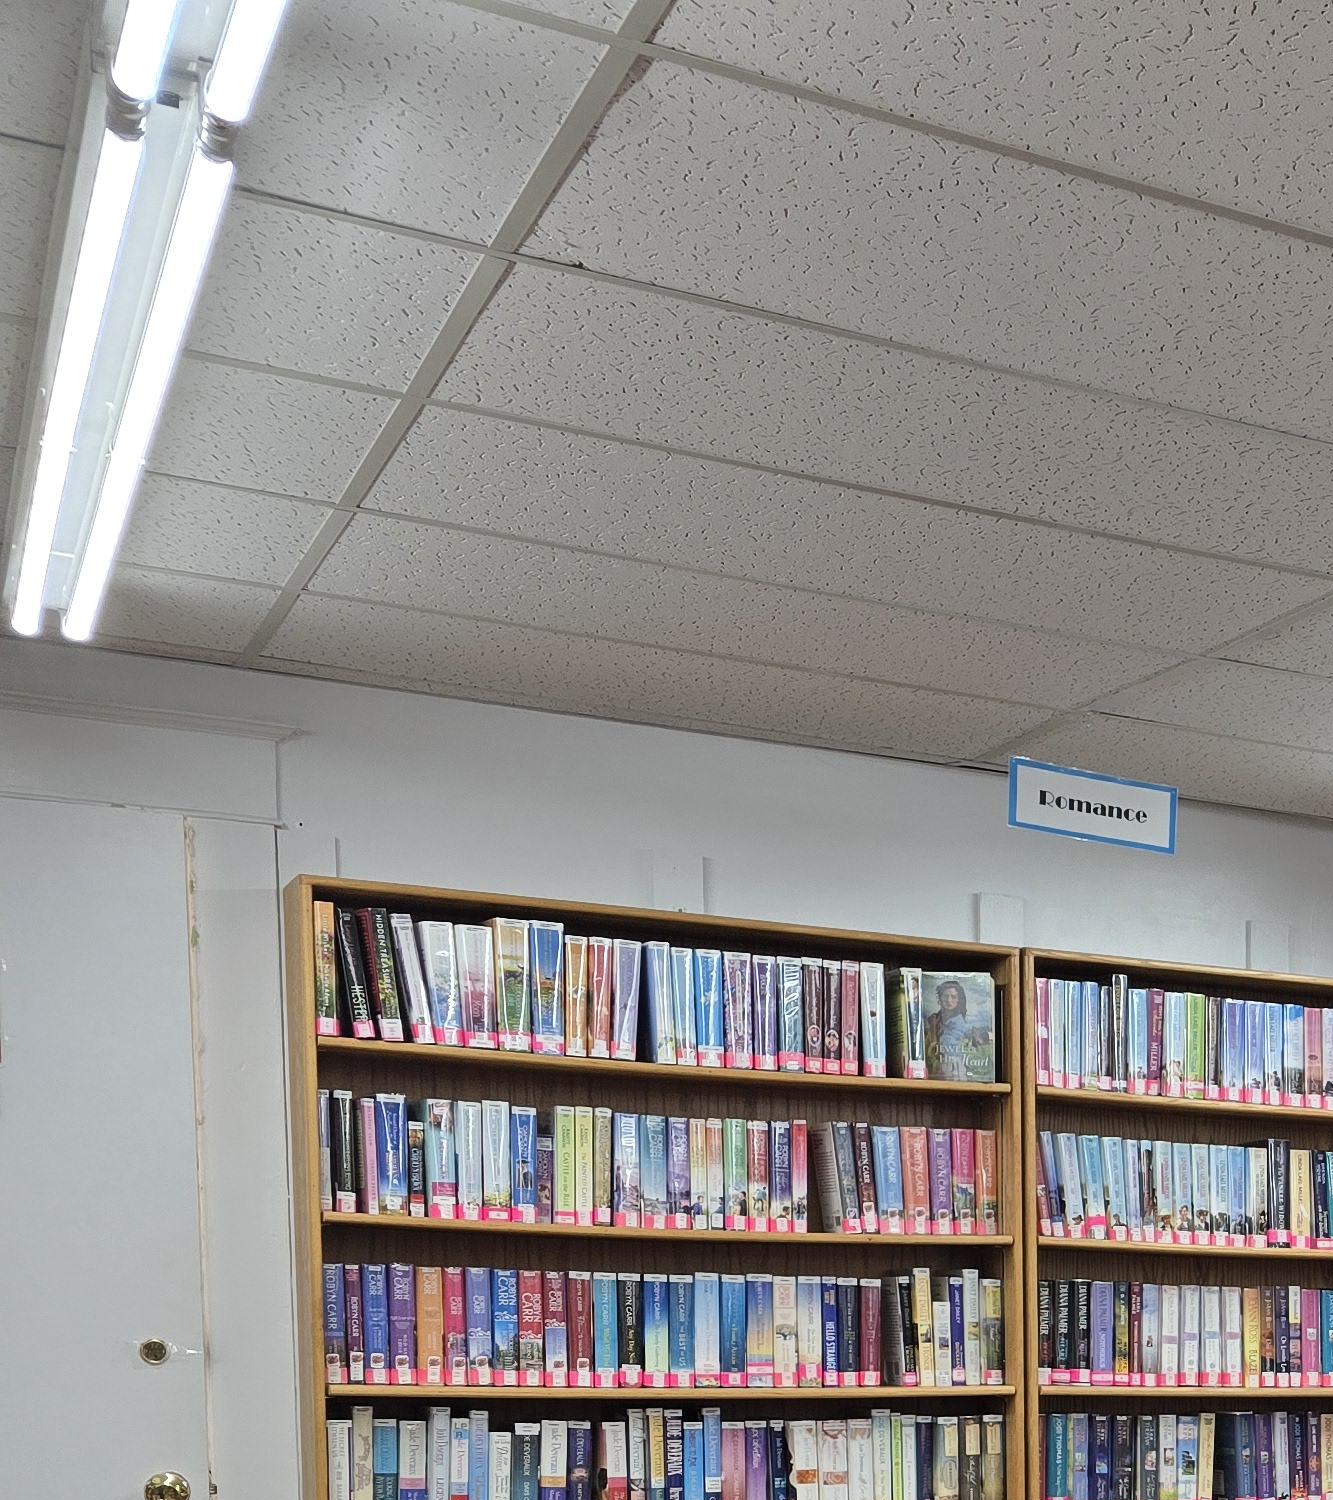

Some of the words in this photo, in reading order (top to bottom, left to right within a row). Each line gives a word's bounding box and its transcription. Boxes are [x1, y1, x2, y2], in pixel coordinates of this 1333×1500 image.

[1039, 789, 1148, 823] Romance
[375, 914, 386, 945] HIDDEN
[379, 946, 392, 994] TREASURES
[1149, 1041, 1158, 1071] MILLER
[910, 1133, 921, 1164] ROBYN
[914, 1166, 924, 1197] CARR
[326, 1269, 336, 1297] ROBYN
[498, 1277, 508, 1305] CARR
[508, 1277, 517, 1306] ROBYN
[327, 1301, 337, 1329] CARR
[522, 1292, 532, 1322] CARR
[532, 1293, 541, 1324] ROBYN
[1247, 1324, 1257, 1345] ROSS
[1248, 1349, 1258, 1375] BLAZE
